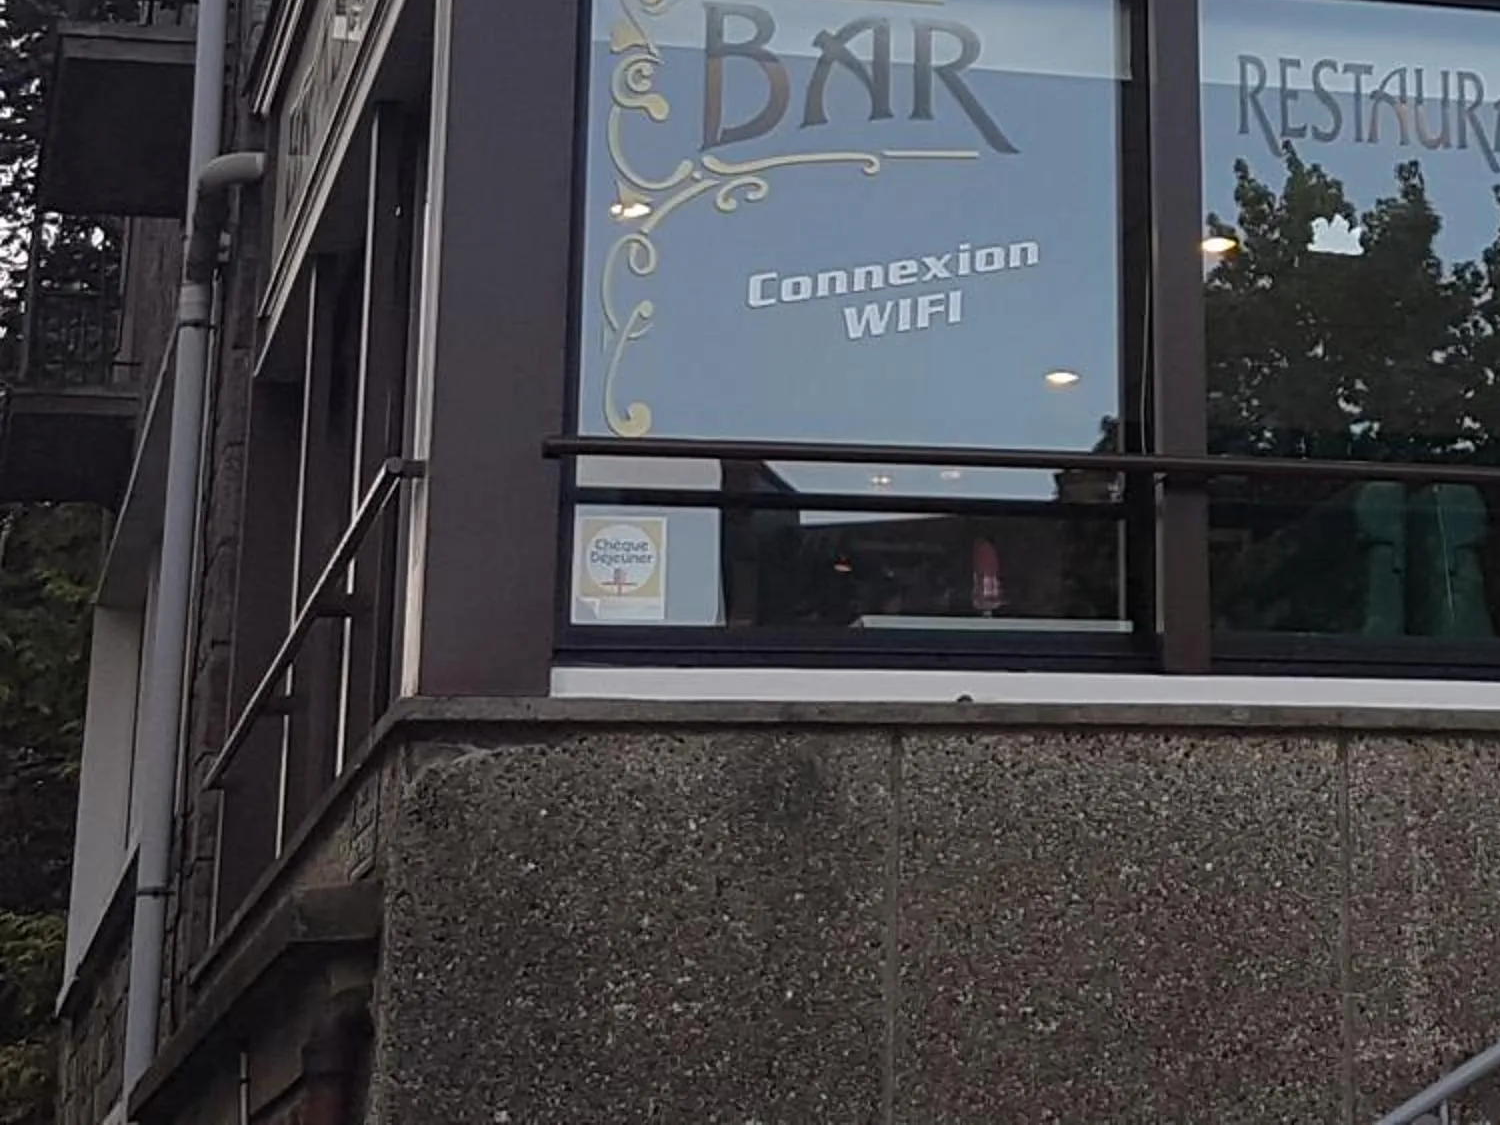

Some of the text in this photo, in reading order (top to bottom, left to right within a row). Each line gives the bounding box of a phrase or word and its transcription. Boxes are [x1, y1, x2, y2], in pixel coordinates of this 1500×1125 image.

[698, 0, 1022, 154] BAR
[748, 240, 1040, 309] Connexion
[843, 290, 963, 340] WIFI
